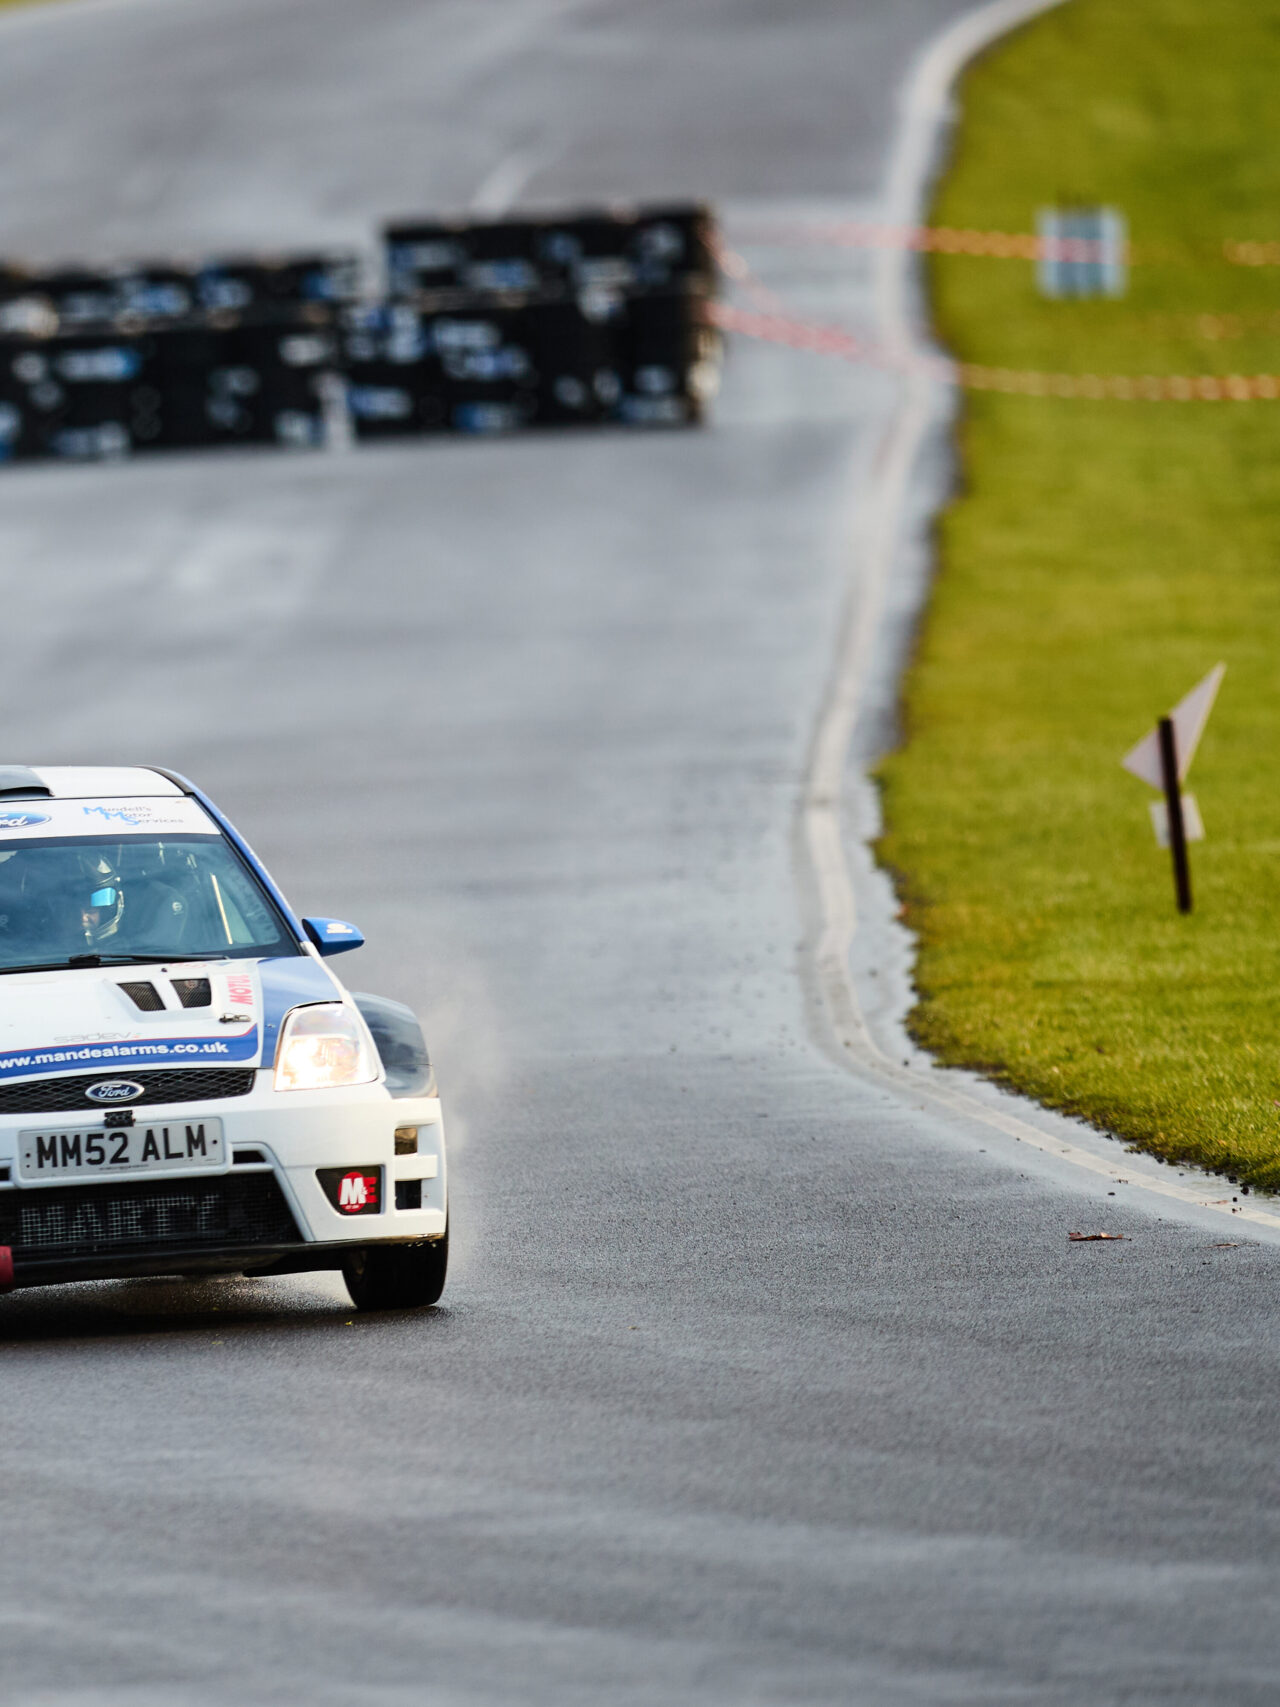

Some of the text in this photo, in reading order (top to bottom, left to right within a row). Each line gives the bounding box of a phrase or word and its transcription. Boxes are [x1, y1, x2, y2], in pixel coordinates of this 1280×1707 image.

[98, 1084, 129, 1098] Ford
[36, 1125, 207, 1168] MM52 ALM
